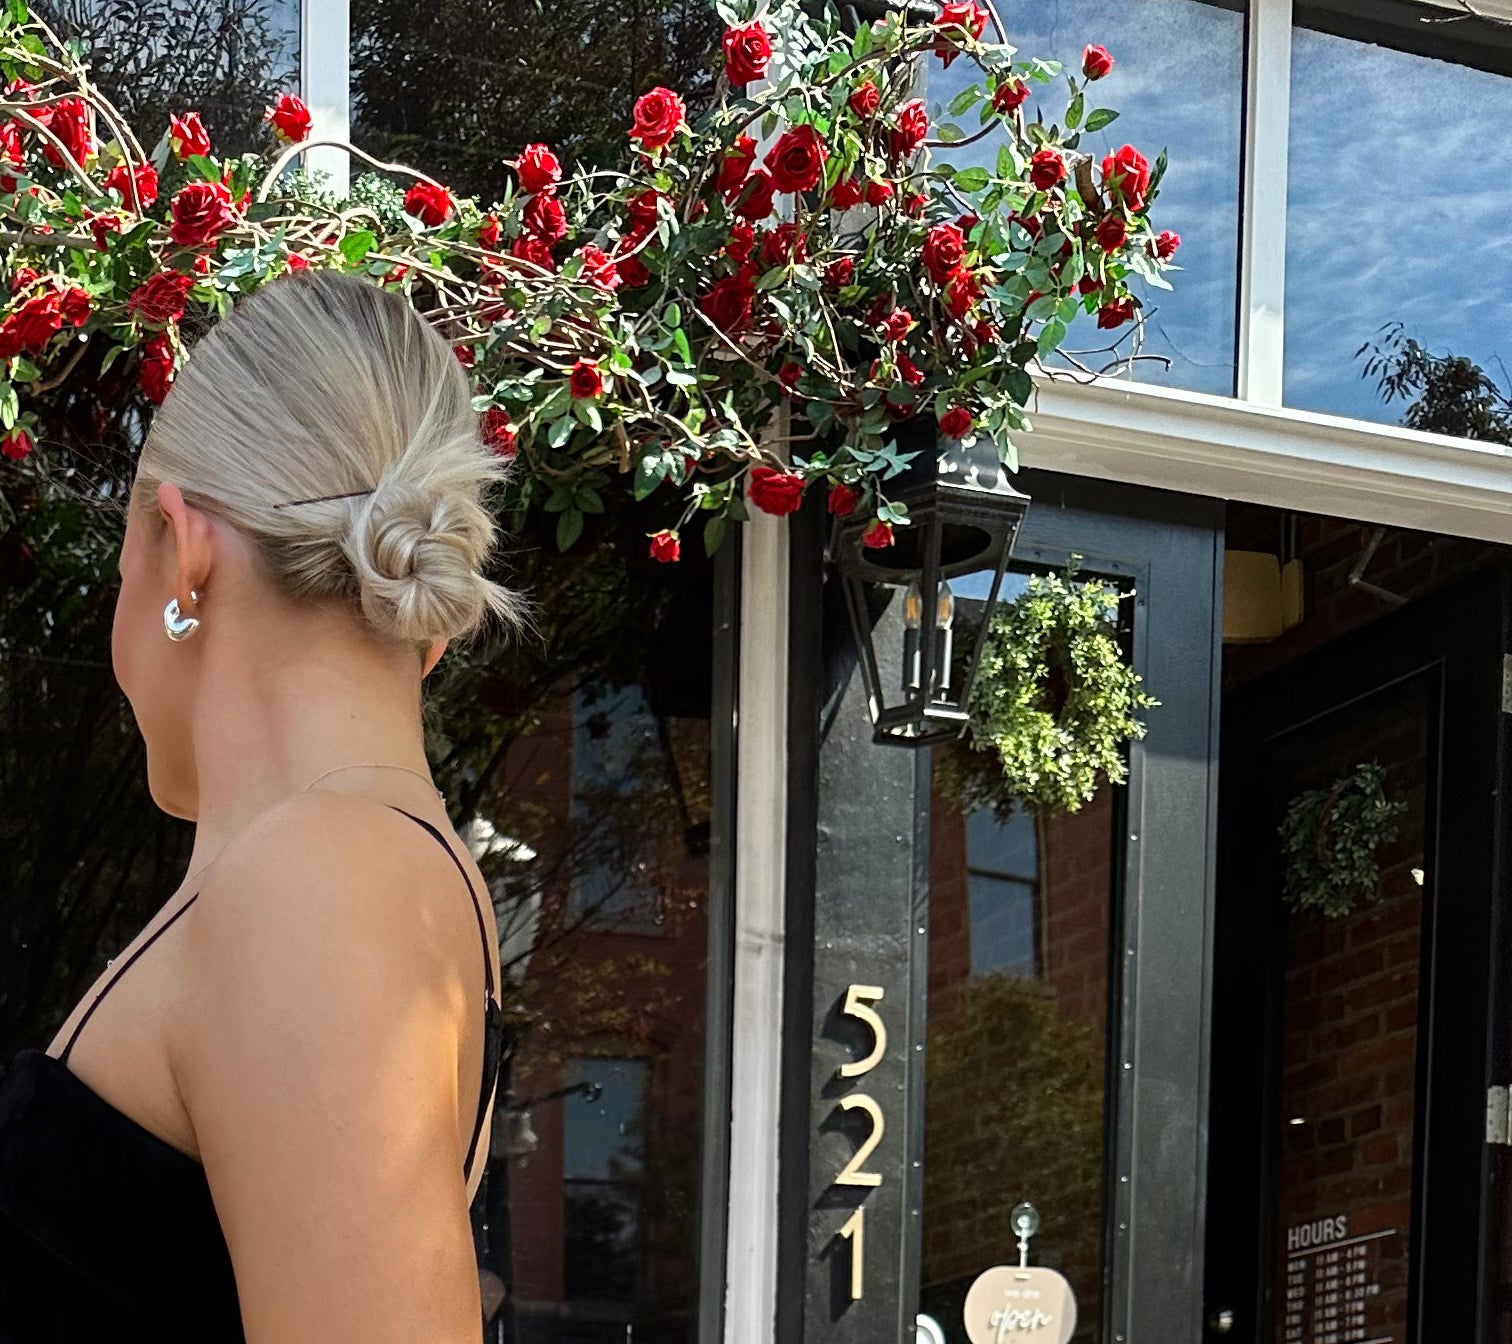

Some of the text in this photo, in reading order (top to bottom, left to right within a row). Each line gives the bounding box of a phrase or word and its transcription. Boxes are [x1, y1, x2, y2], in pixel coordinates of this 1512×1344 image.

[835, 983, 886, 1300] 521
[1287, 1216, 1346, 1250] HOURS
[1353, 1246, 1366, 1258] PM
[1352, 1259, 1366, 1272] PM
[1352, 1273, 1365, 1286] PM
[1366, 1284, 1379, 1296] PM
[1351, 1301, 1364, 1313] PM
[990, 1303, 1054, 1344] open
[1351, 1314, 1365, 1327] PM
[1351, 1328, 1364, 1340] PM
